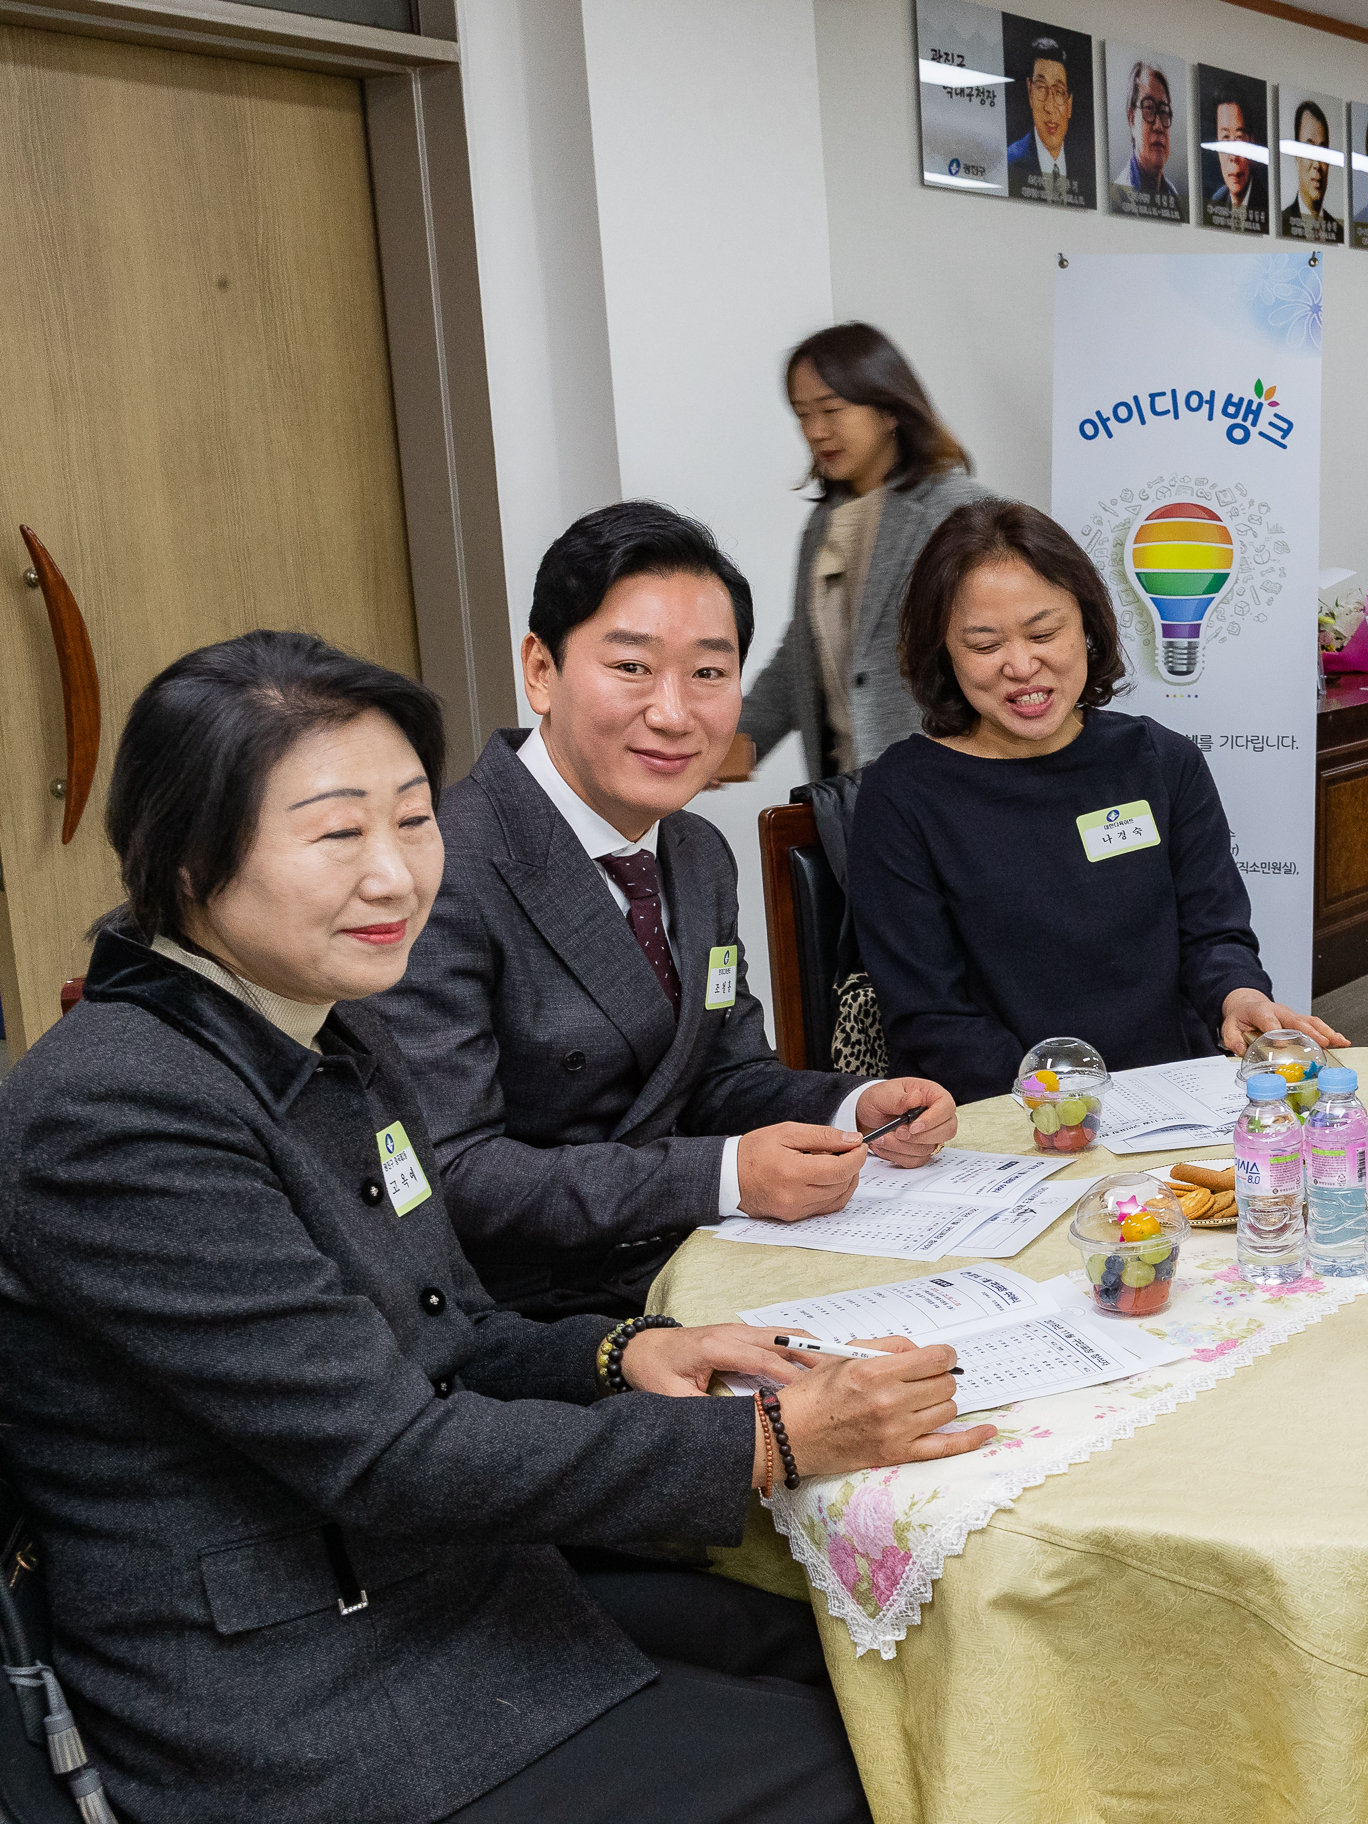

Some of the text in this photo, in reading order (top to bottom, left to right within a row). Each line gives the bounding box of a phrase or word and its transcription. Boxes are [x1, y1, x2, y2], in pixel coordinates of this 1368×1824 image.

[1078, 388, 1295, 450] 아이디어뱅크
[1219, 735, 1300, 753] 기다립니다.
[1247, 1174, 1261, 1185] 8.0
